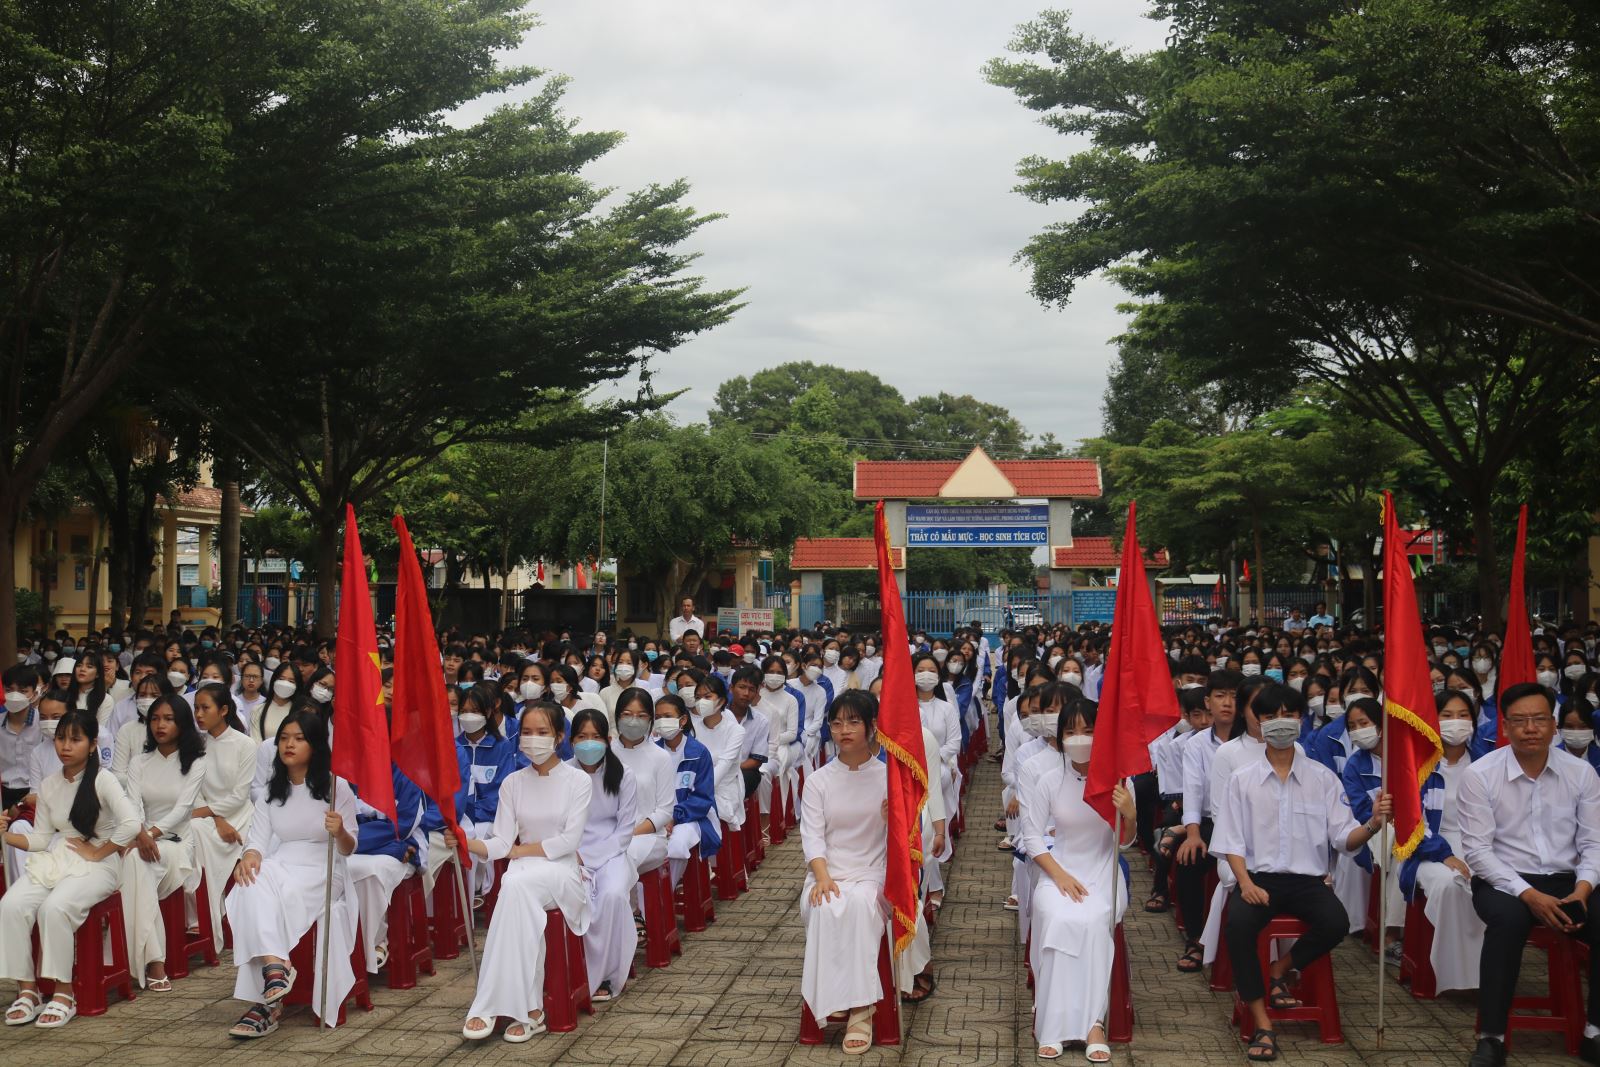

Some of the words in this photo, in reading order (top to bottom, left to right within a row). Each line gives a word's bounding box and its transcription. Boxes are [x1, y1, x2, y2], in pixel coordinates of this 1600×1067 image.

[910, 529, 929, 541] THẦY
[930, 532, 940, 541] CÔ
[958, 532, 974, 542] MỰC
[979, 533, 994, 543] HỌC
[995, 533, 1012, 541] SINH
[1013, 531, 1030, 541] TÍCH
[1031, 532, 1046, 542] CỰC
